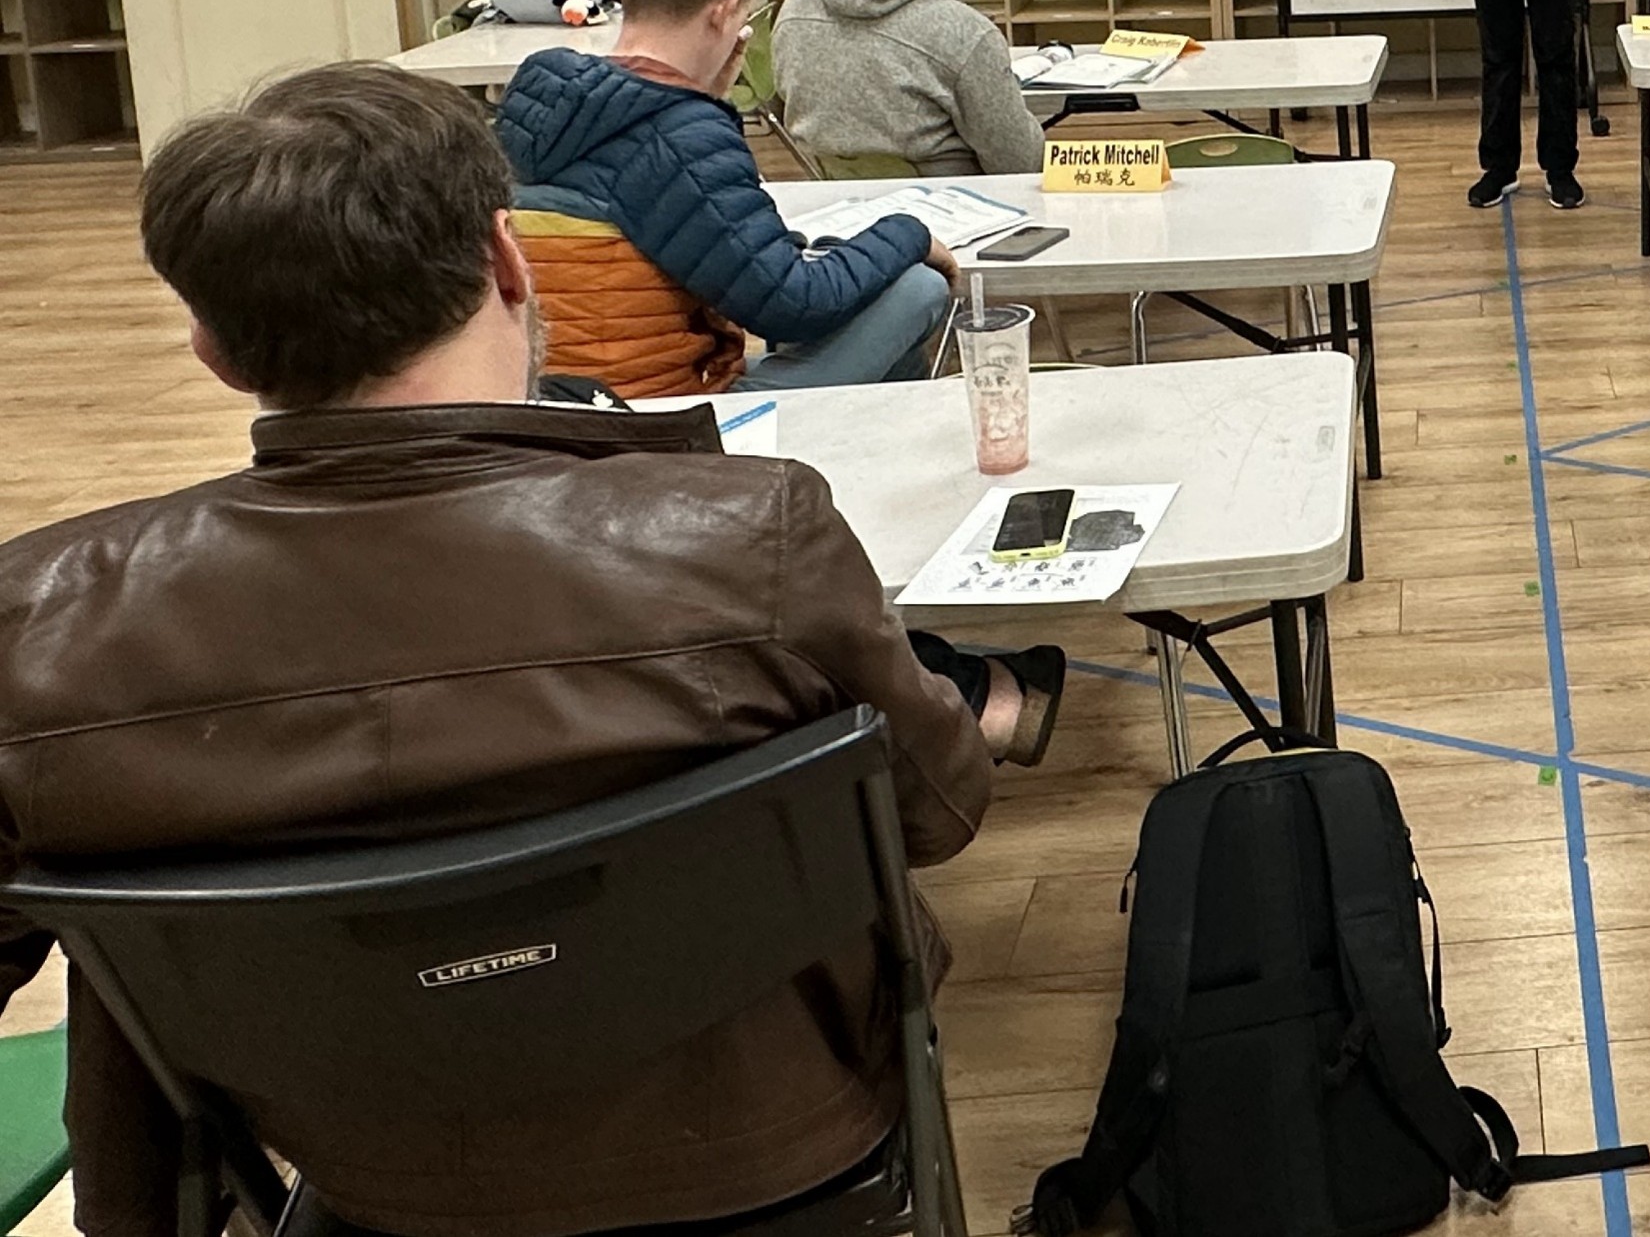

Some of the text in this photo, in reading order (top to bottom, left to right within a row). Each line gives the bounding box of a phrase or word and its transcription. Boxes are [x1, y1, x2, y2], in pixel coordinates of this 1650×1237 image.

[1050, 144, 1159, 166] Patrick Mitchell
[1074, 167, 1135, 187] 帕瑞克
[436, 950, 542, 981] LIFETIME
